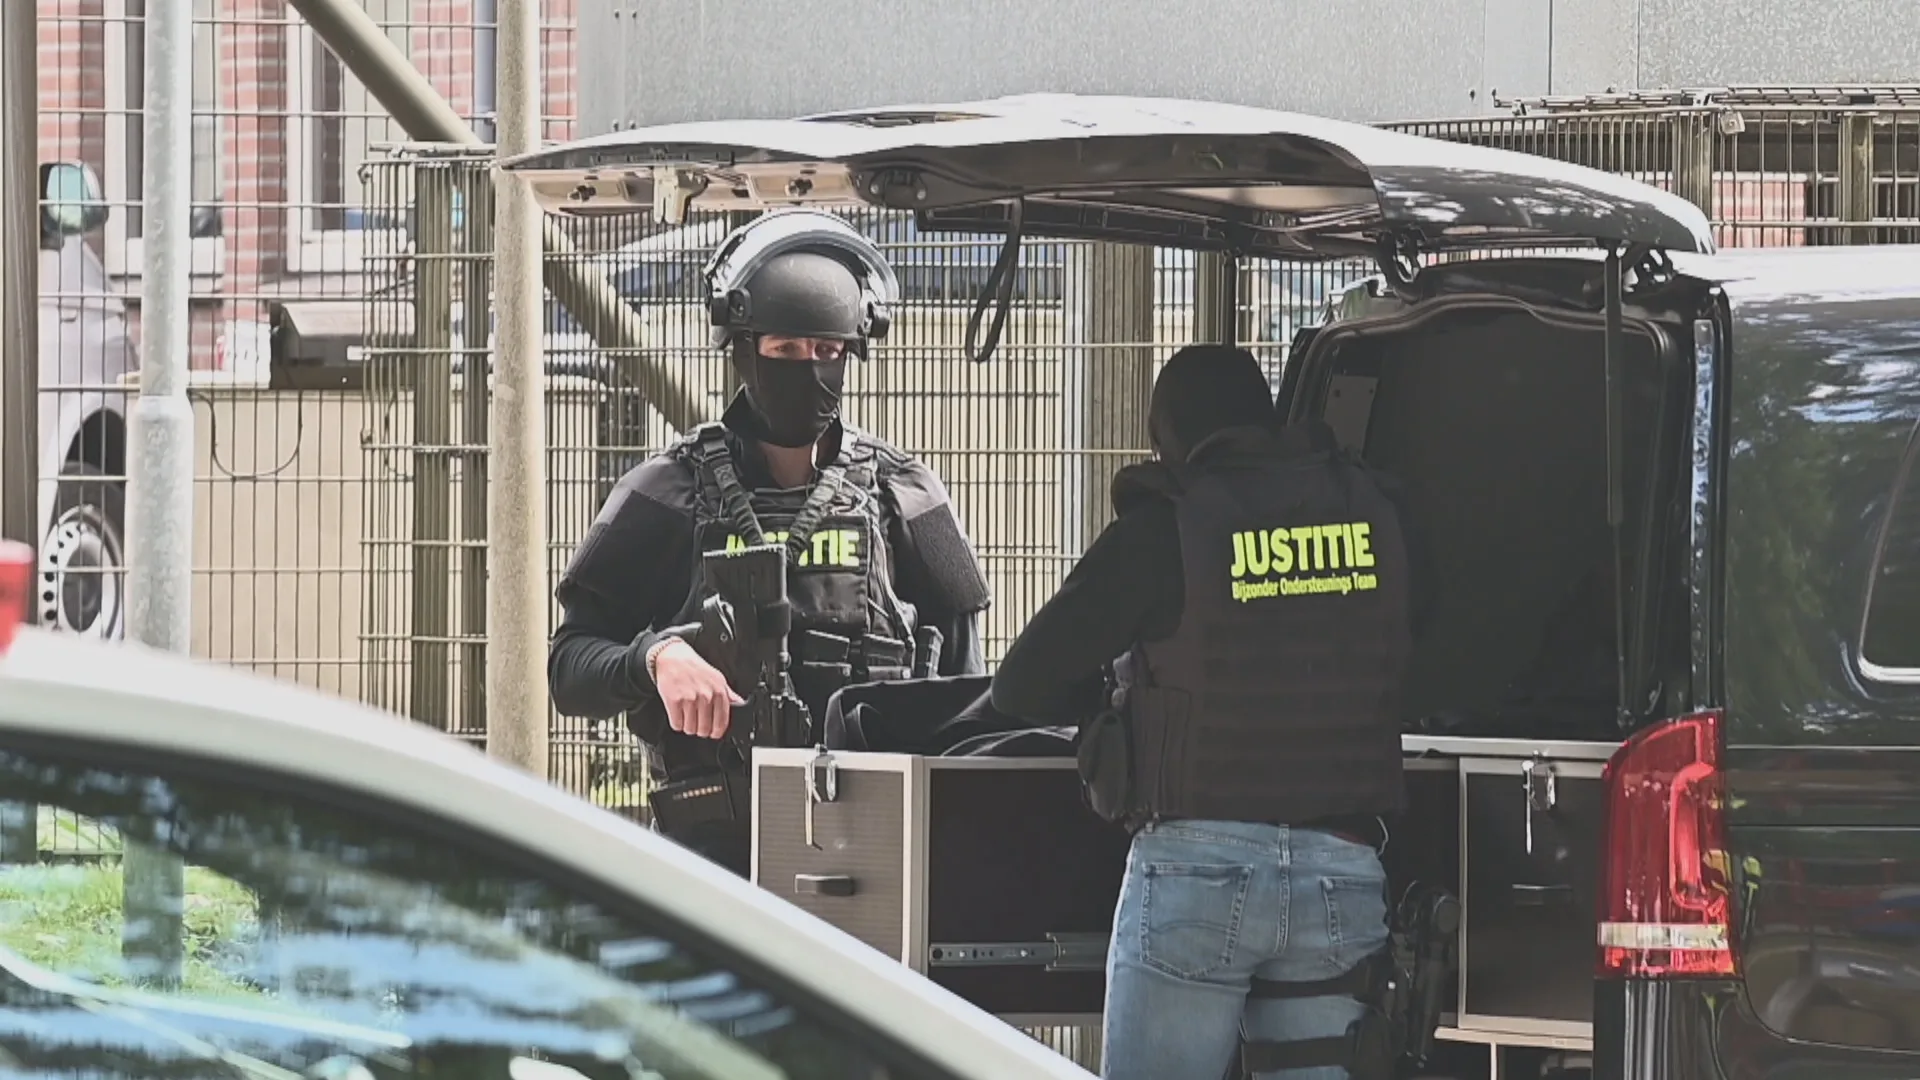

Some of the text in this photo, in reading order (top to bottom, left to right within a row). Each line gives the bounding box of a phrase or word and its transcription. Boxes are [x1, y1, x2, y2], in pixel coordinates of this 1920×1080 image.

[1231, 522, 1375, 578] JUSTITIE
[1232, 571, 1377, 603] Bijzonder Ondersteunings Team
